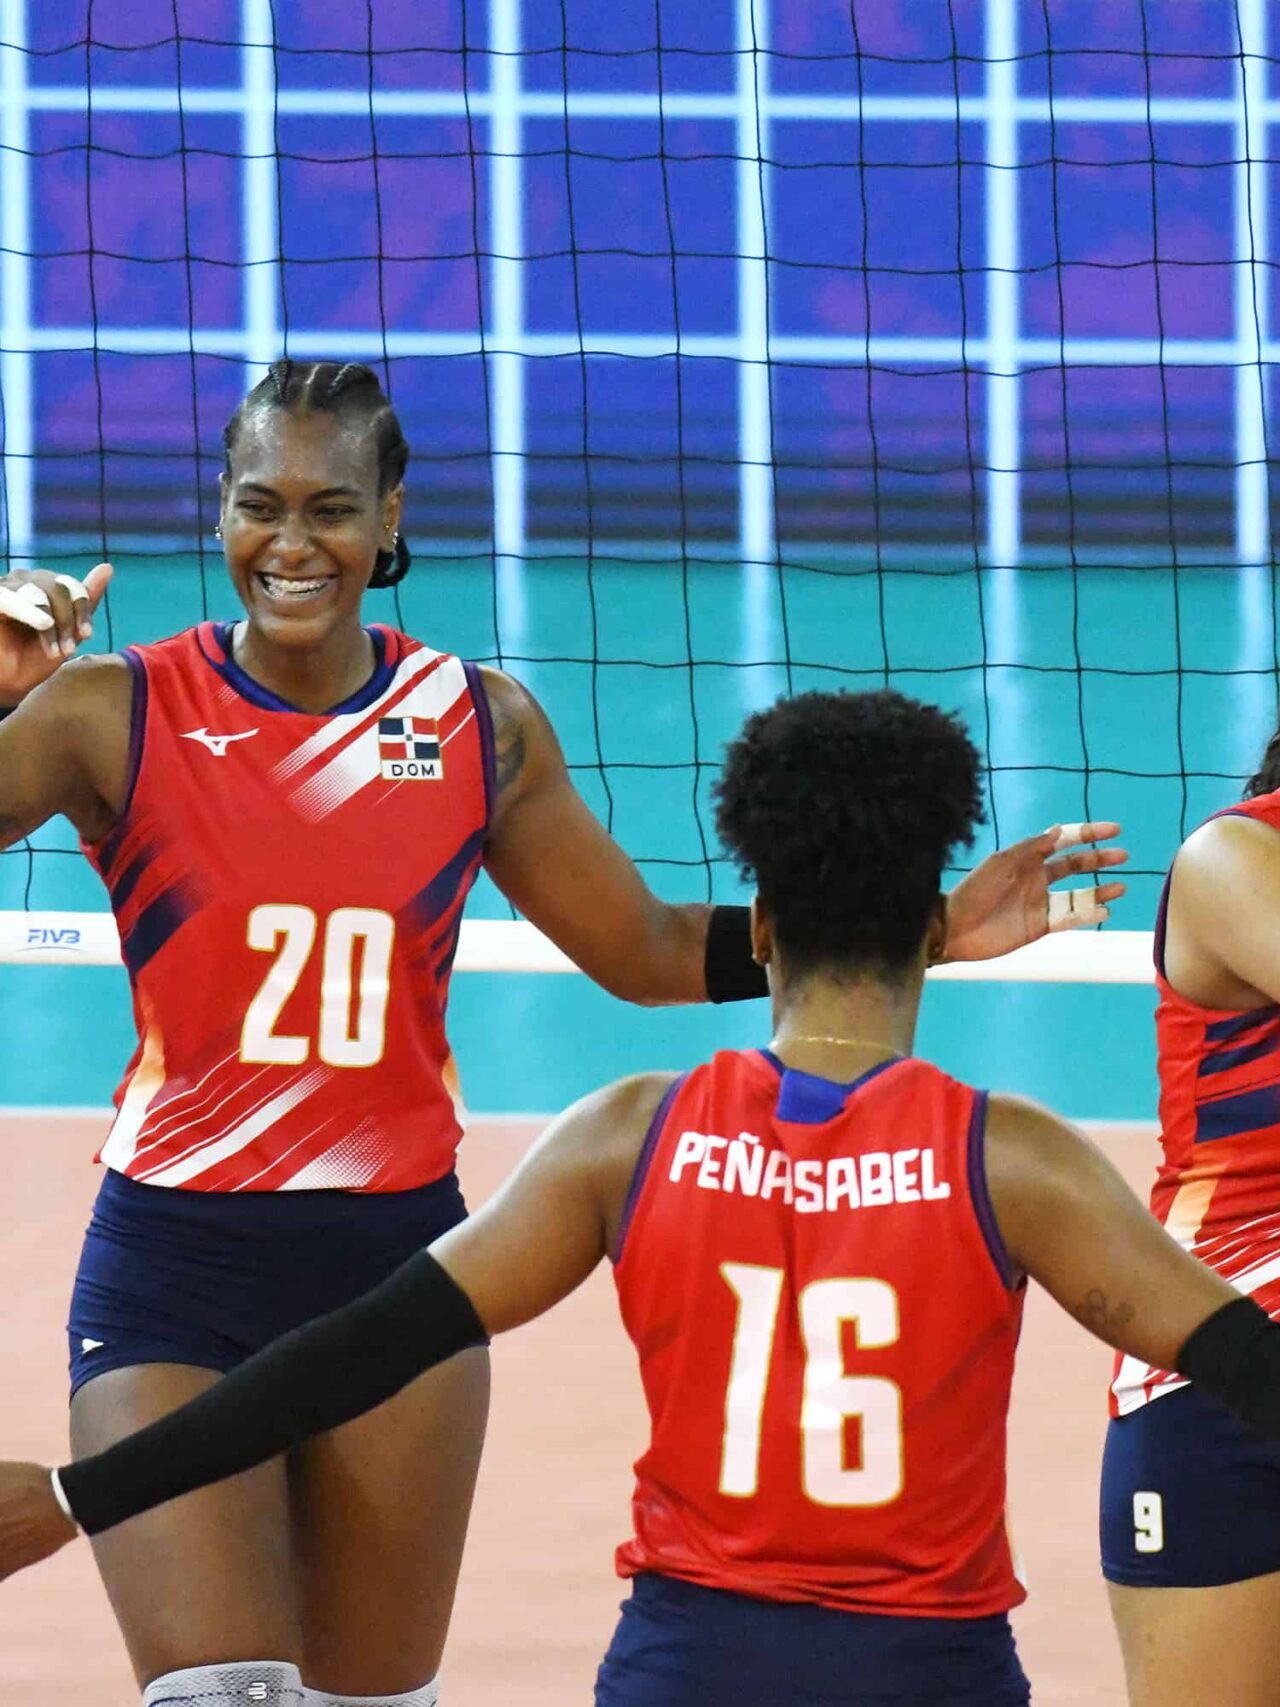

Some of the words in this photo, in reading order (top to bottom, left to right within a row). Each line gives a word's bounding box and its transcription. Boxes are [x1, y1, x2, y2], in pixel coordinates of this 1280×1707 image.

[391, 763, 435, 777] DOM
[27, 928, 81, 944] FIVB
[239, 903, 395, 1068] 20
[718, 1261, 905, 1509] 16
[1132, 1490, 1165, 1553] 9
